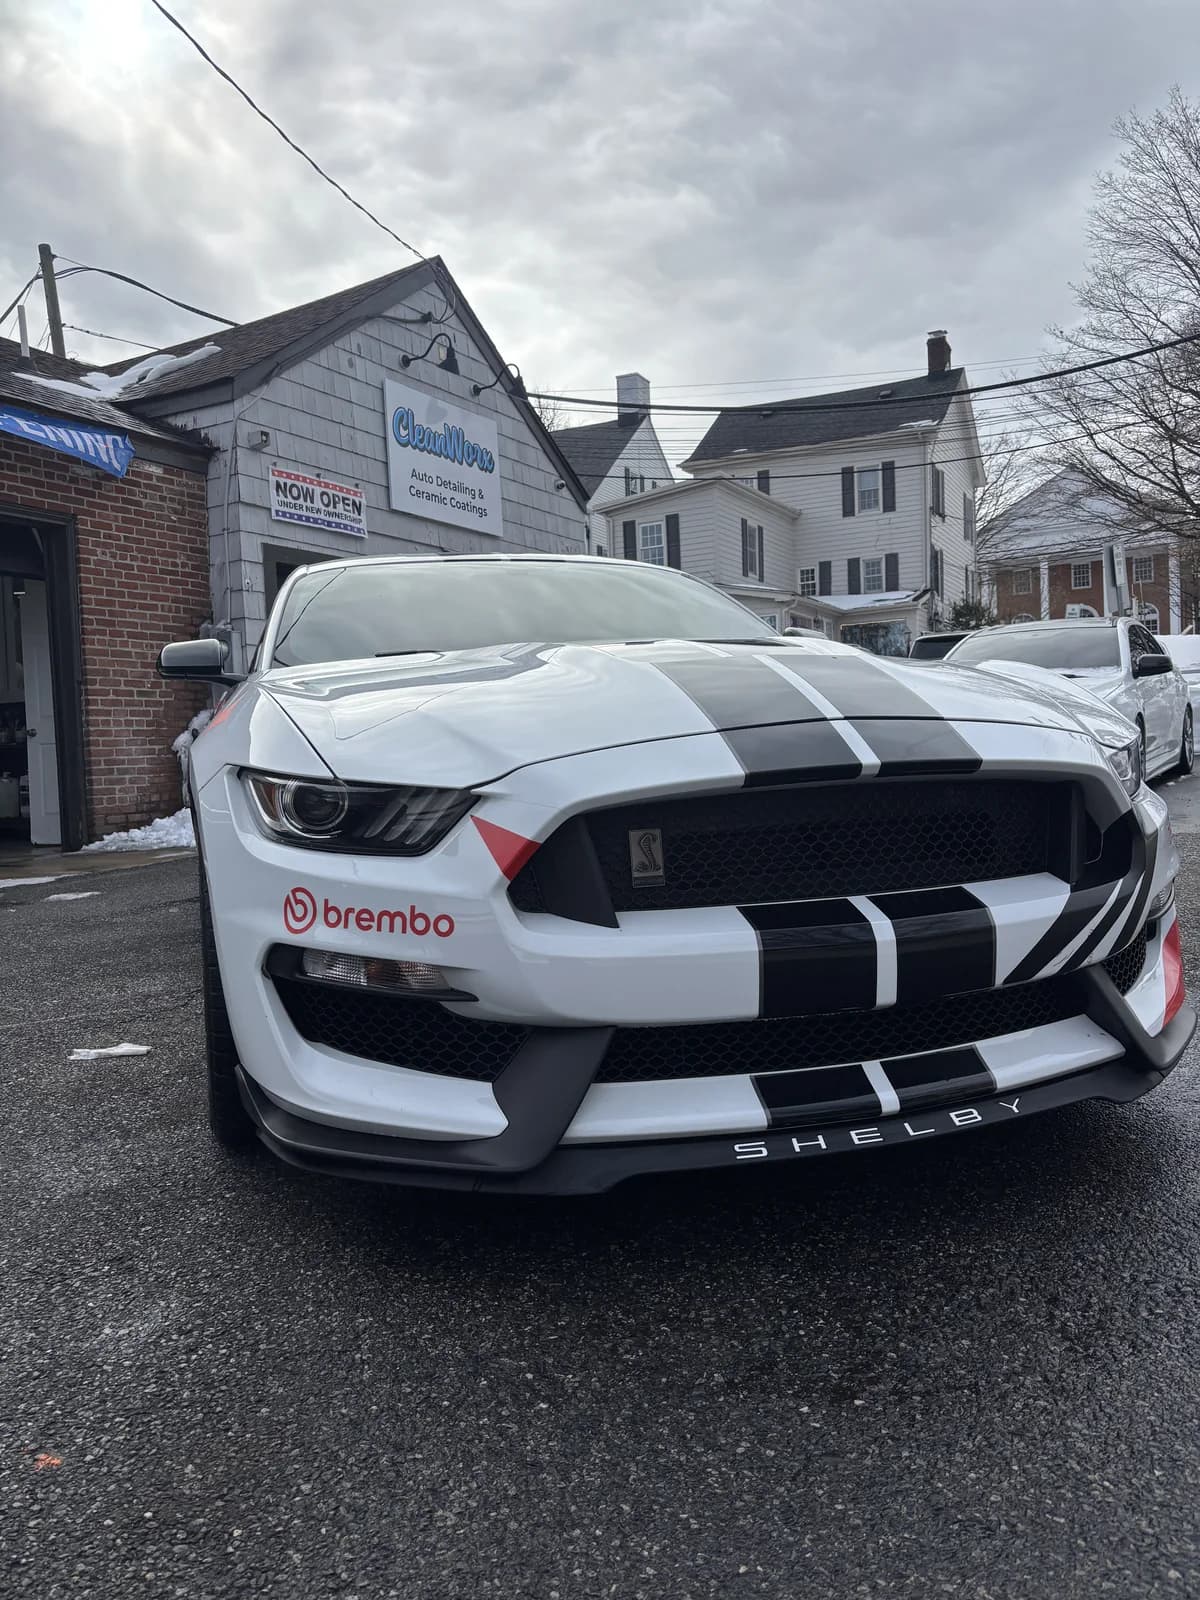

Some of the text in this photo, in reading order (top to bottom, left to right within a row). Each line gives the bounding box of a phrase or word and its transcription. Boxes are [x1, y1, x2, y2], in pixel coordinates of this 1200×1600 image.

[392, 406, 495, 474] CleanWorx
[275, 479, 362, 516] NOW OPEN
[408, 485, 488, 518] Ceramic Coatings
[410, 468, 484, 500] Auto Detailing &
[277, 499, 362, 524] UNDER NEW OWNERSHIP
[323, 898, 455, 938] brembo
[734, 1098, 1020, 1160] SHELBY
